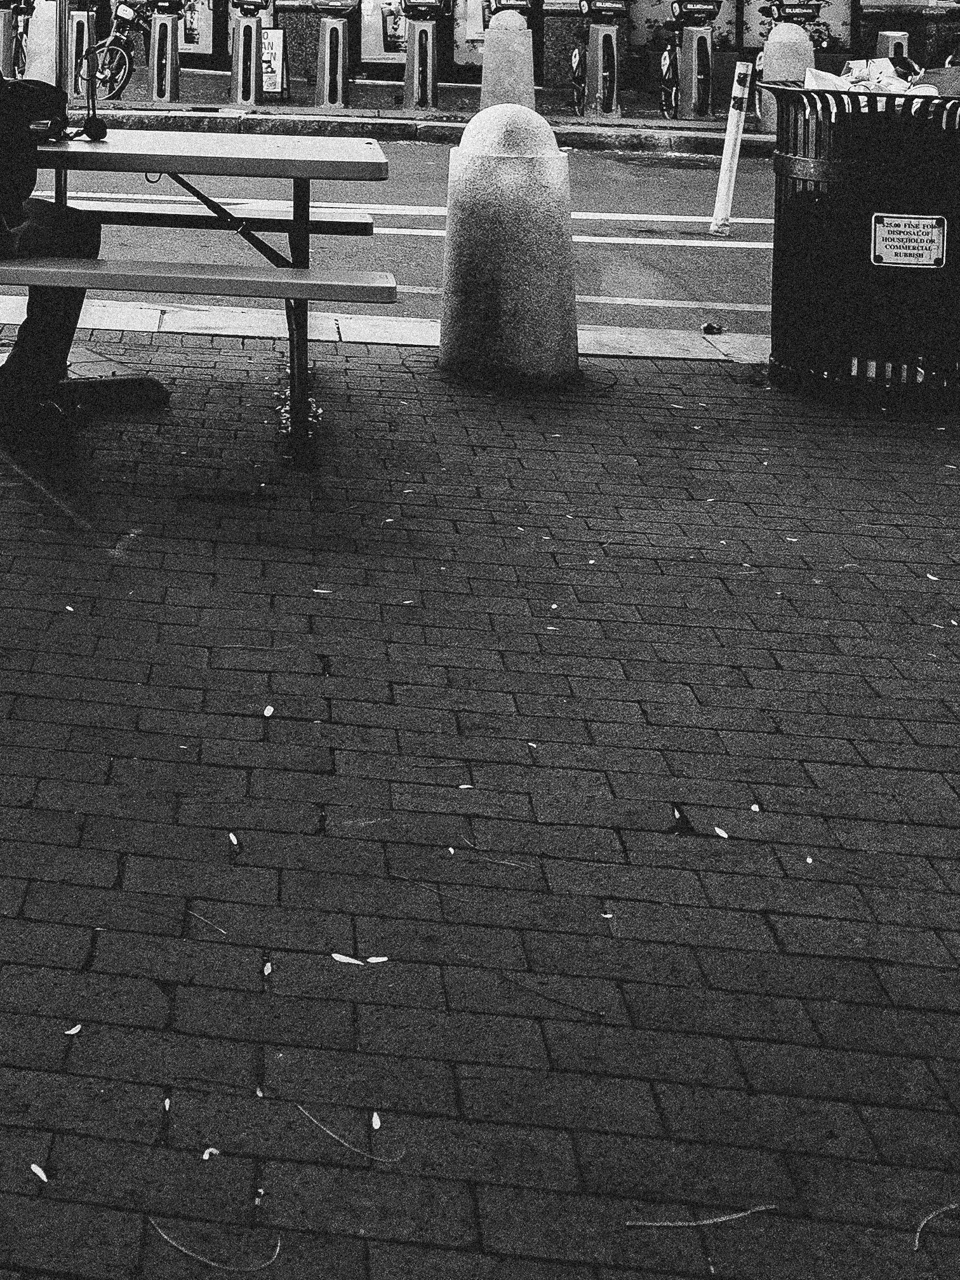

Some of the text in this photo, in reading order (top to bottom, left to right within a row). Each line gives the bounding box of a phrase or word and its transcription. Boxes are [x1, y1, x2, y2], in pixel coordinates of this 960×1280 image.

[903, 222, 920, 230] FINE
[887, 229, 922, 237] DISPOSAL
[881, 236, 925, 244] HOUSEHOLD
[884, 244, 933, 252] COMMERCIAL
[894, 251, 925, 259] RUBBISH
